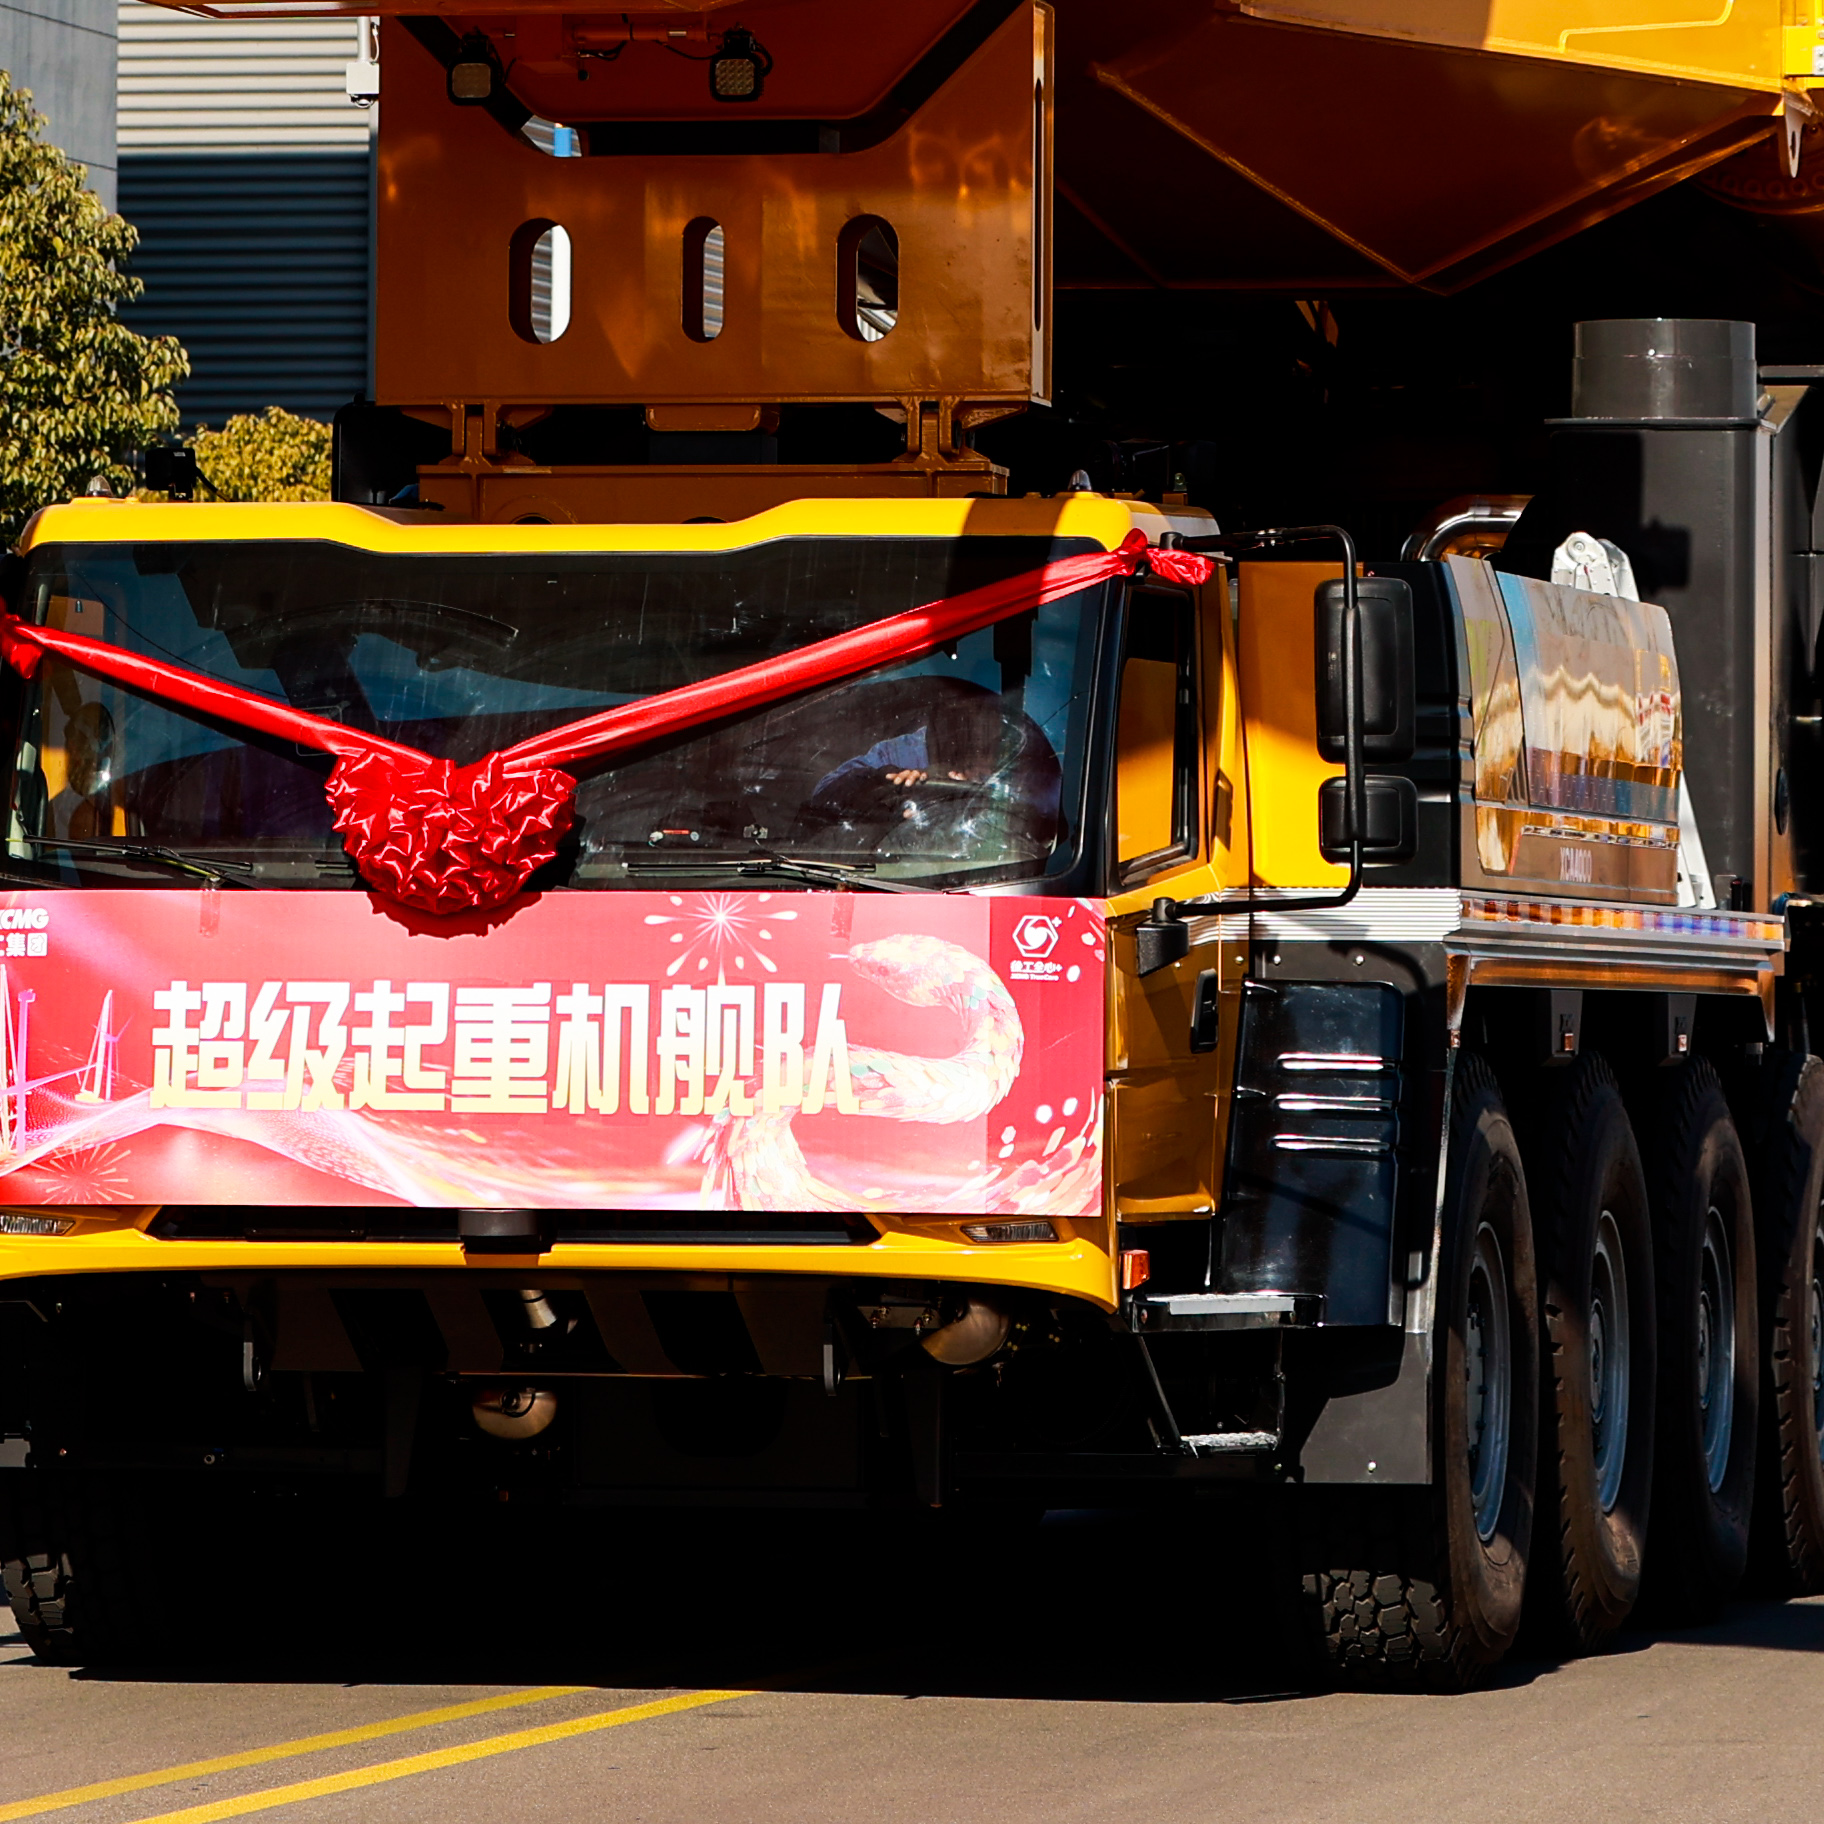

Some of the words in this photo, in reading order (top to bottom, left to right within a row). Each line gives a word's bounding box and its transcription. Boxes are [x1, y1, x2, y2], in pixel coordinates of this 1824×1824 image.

[149, 980, 862, 1116] 超级起重机舰队
